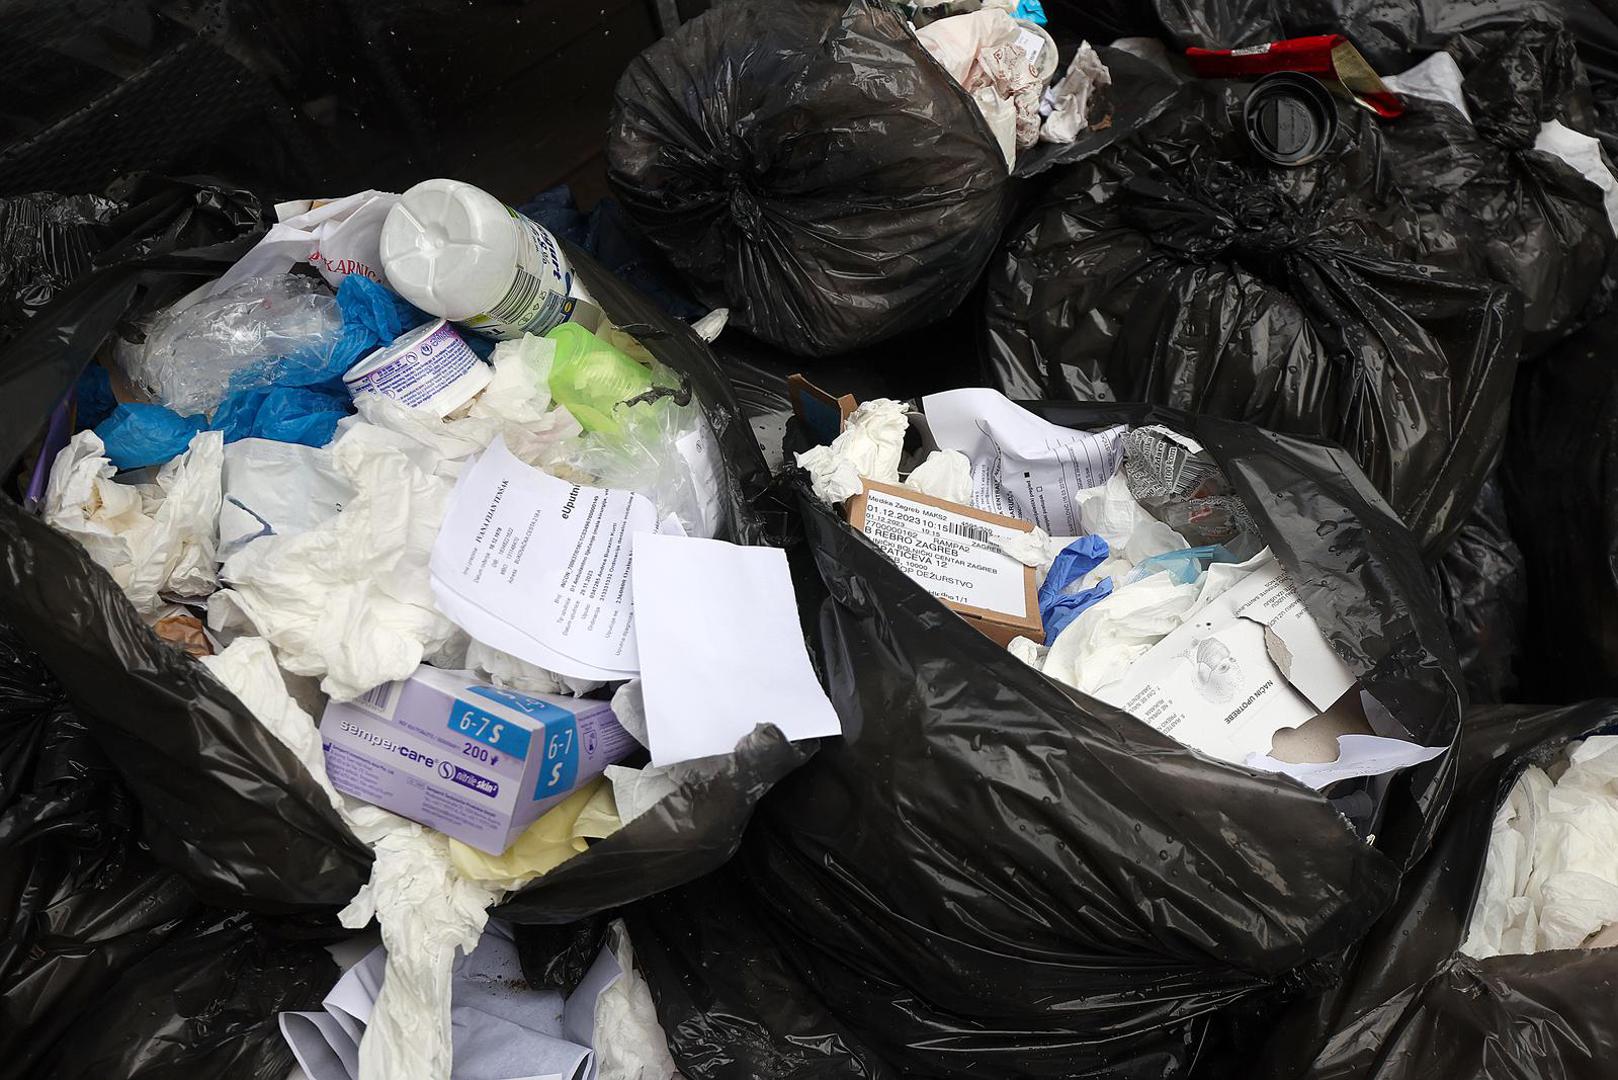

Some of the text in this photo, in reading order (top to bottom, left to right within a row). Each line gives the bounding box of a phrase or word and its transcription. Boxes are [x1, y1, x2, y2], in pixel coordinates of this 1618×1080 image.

[868, 495, 893, 506] Medika
[894, 502, 920, 514] Zagreb
[867, 504, 920, 525] 01.12.2023
[923, 520, 948, 532] 10:15
[874, 528, 912, 544] REBRO
[915, 540, 958, 557] ZAGREB
[933, 538, 970, 553] RAMPA2
[906, 561, 928, 570] 10000
[934, 554, 965, 566] CENTAR
[966, 562, 997, 574] ZAGREB
[936, 560, 947, 568] 12
[916, 567, 973, 588] DEŽURSTVO
[1224, 680, 1273, 724] NAČIN UPOTREBE
[459, 711, 490, 737] 6-7
[488, 724, 504, 744] S
[463, 742, 488, 762] 200
[548, 729, 573, 759] 6-7
[548, 762, 563, 786] S
